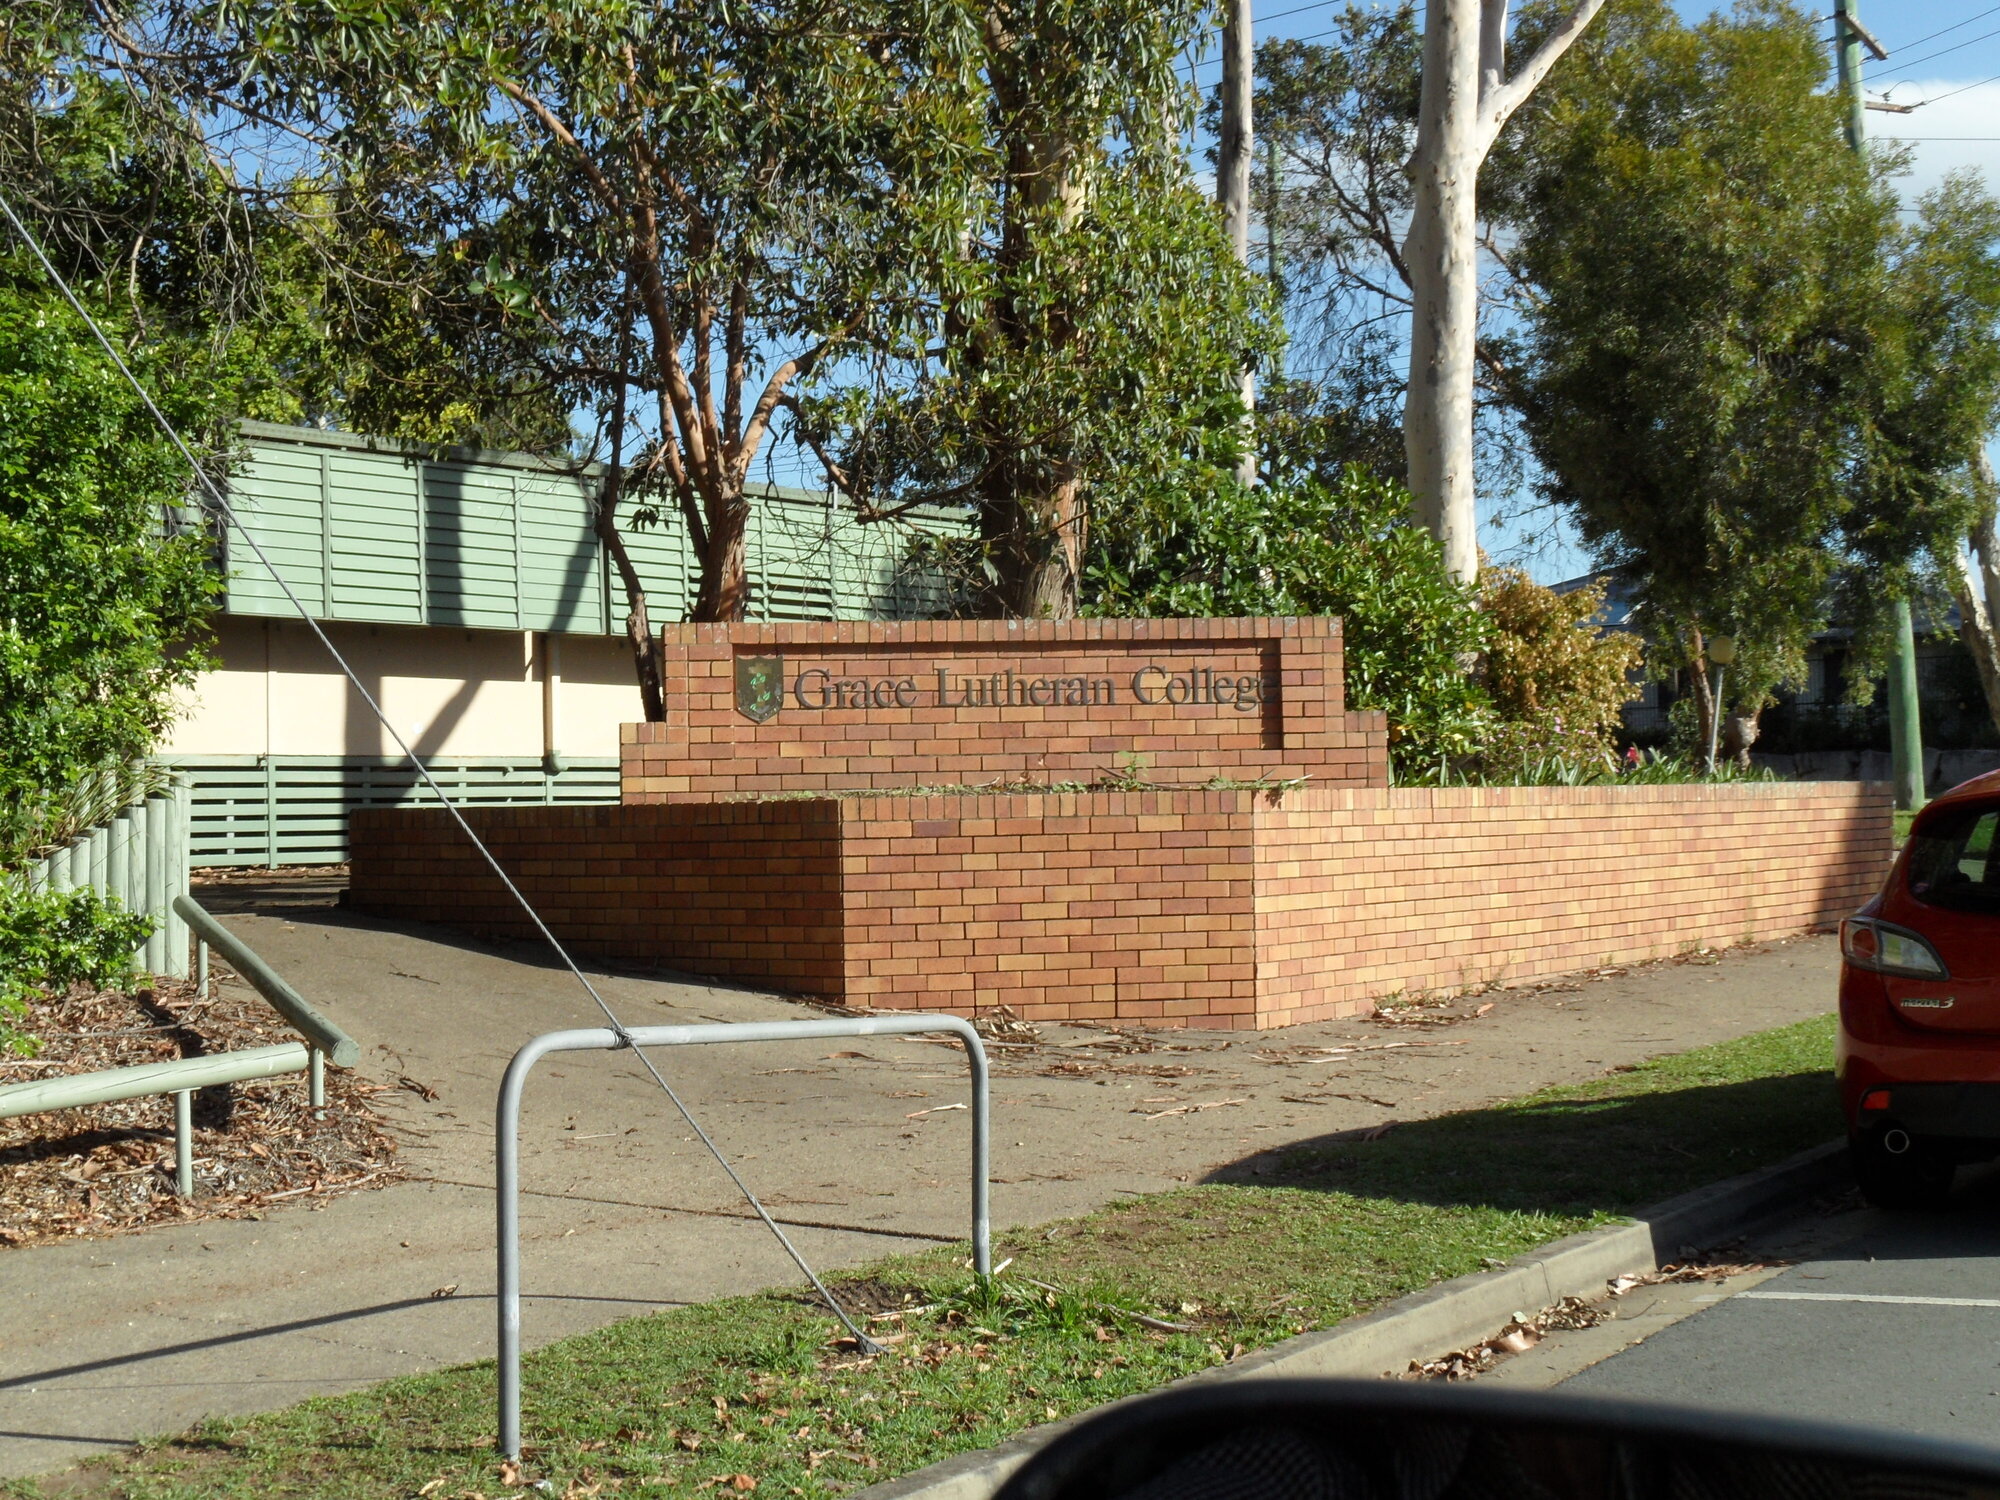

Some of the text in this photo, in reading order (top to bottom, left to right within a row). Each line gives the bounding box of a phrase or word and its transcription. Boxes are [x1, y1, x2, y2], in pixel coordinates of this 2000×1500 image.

[794, 665, 1277, 712] Grace Lutheran College
